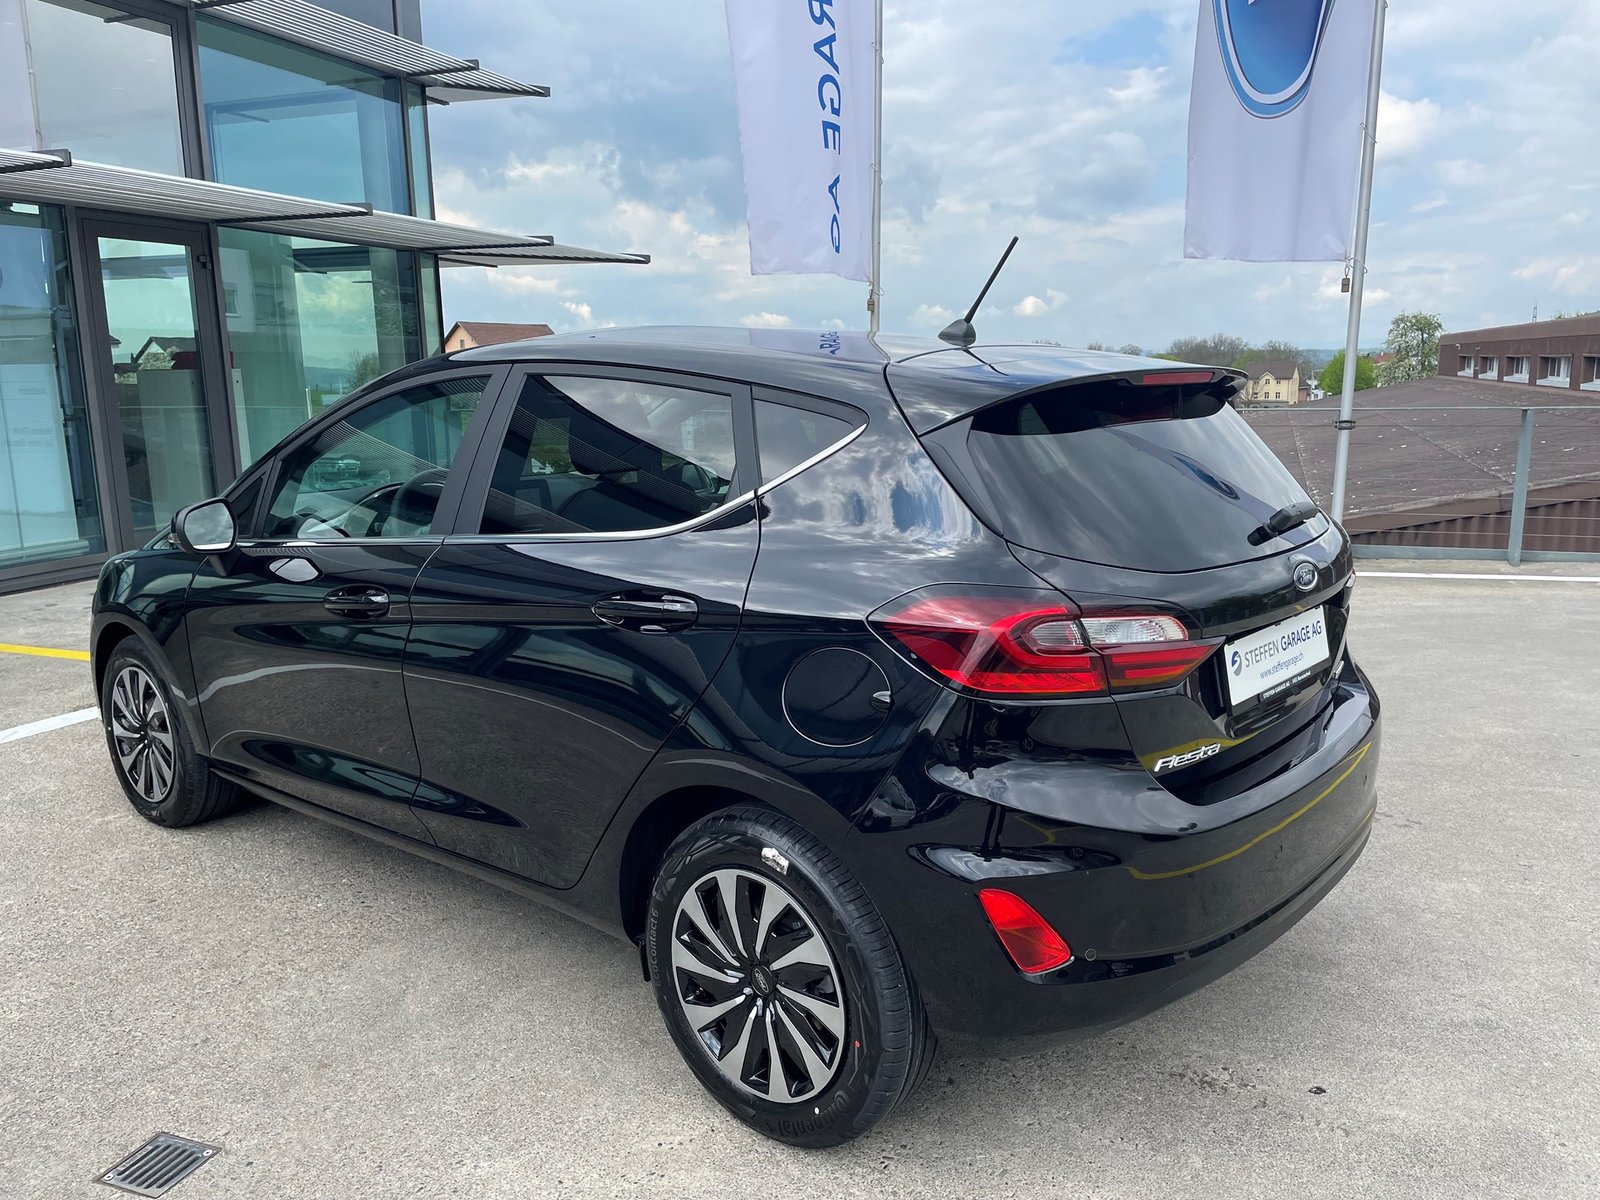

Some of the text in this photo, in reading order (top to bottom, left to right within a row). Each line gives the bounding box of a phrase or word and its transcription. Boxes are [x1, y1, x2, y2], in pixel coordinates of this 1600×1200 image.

[1244, 620, 1322, 668] STEFFEN GARAGE AG
[1260, 652, 1305, 680] www.steffengarage.ch
[1153, 743, 1221, 772] Fiesta
[649, 907, 661, 987] EcoContact 6
